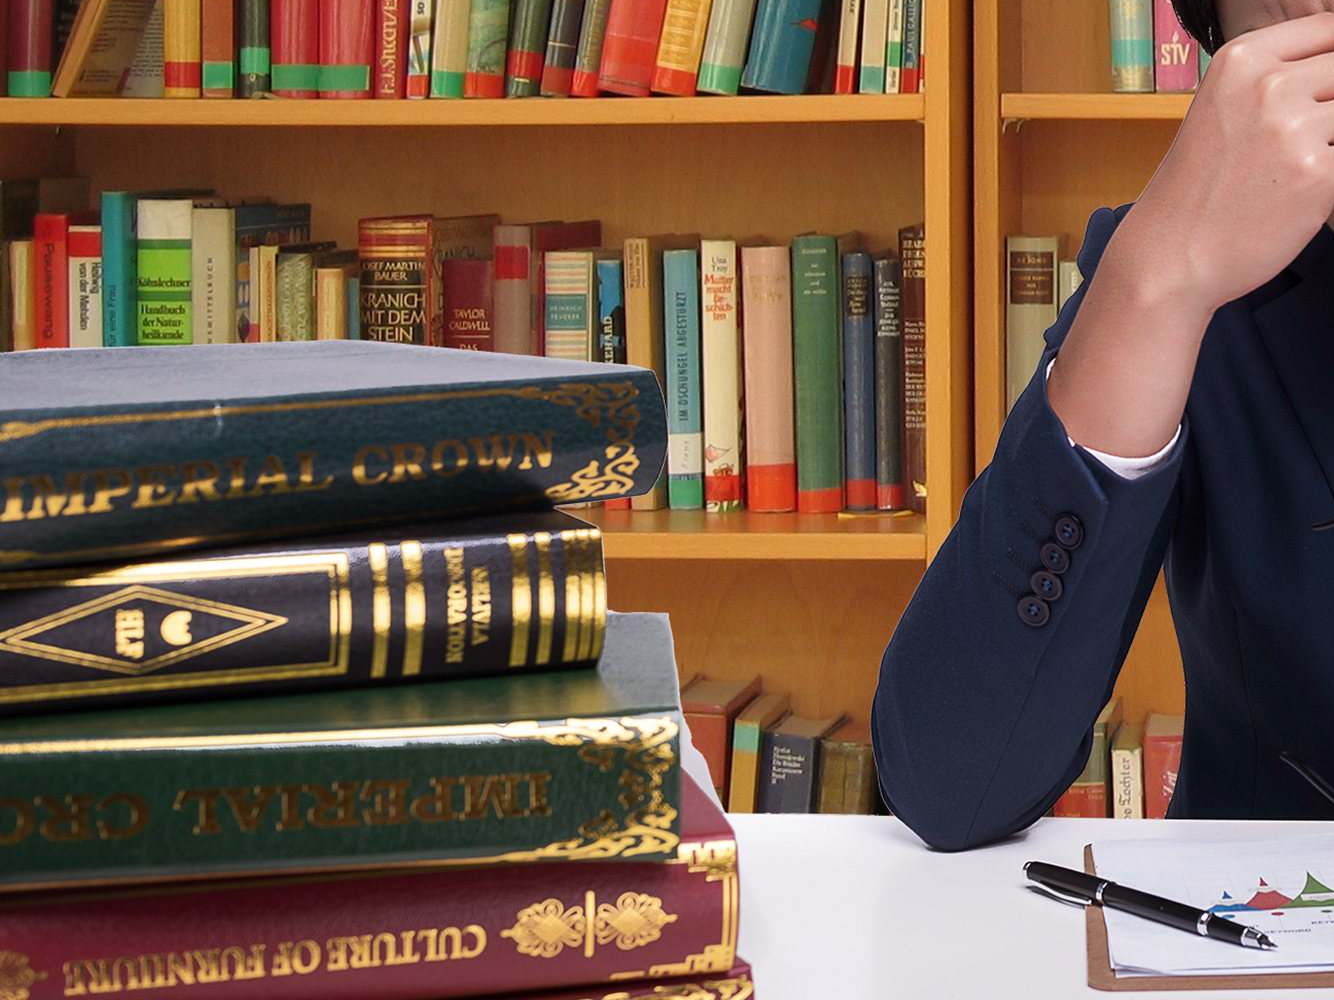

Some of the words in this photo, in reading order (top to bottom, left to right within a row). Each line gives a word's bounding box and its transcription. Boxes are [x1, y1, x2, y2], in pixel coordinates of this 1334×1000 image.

[416, 2, 425, 15] SO
[1160, 43, 1191, 66] STV
[374, 271, 408, 282] BAUER
[706, 284, 732, 293] macht
[362, 292, 425, 308] KRANICH
[140, 304, 186, 316] Handbuch
[388, 310, 426, 324] DEM
[453, 309, 486, 320] TAYLOR
[713, 312, 726, 321] ten
[142, 316, 155, 327] der
[157, 316, 184, 328] Natur-
[449, 320, 491, 332] CALDWELL
[674, 291, 688, 348] ABGESTÜRZT
[142, 329, 184, 340] heilkunde
[367, 326, 413, 342] STEIN
[676, 352, 689, 406] DSCHUNGEL
[677, 408, 689, 422] IM
[0, 450, 334, 524] IMPERIAL
[350, 429, 556, 487] CROWN
[173, 770, 553, 837] IMPERIAL
[326, 924, 488, 972] CULTURE
[271, 938, 321, 977] OF
